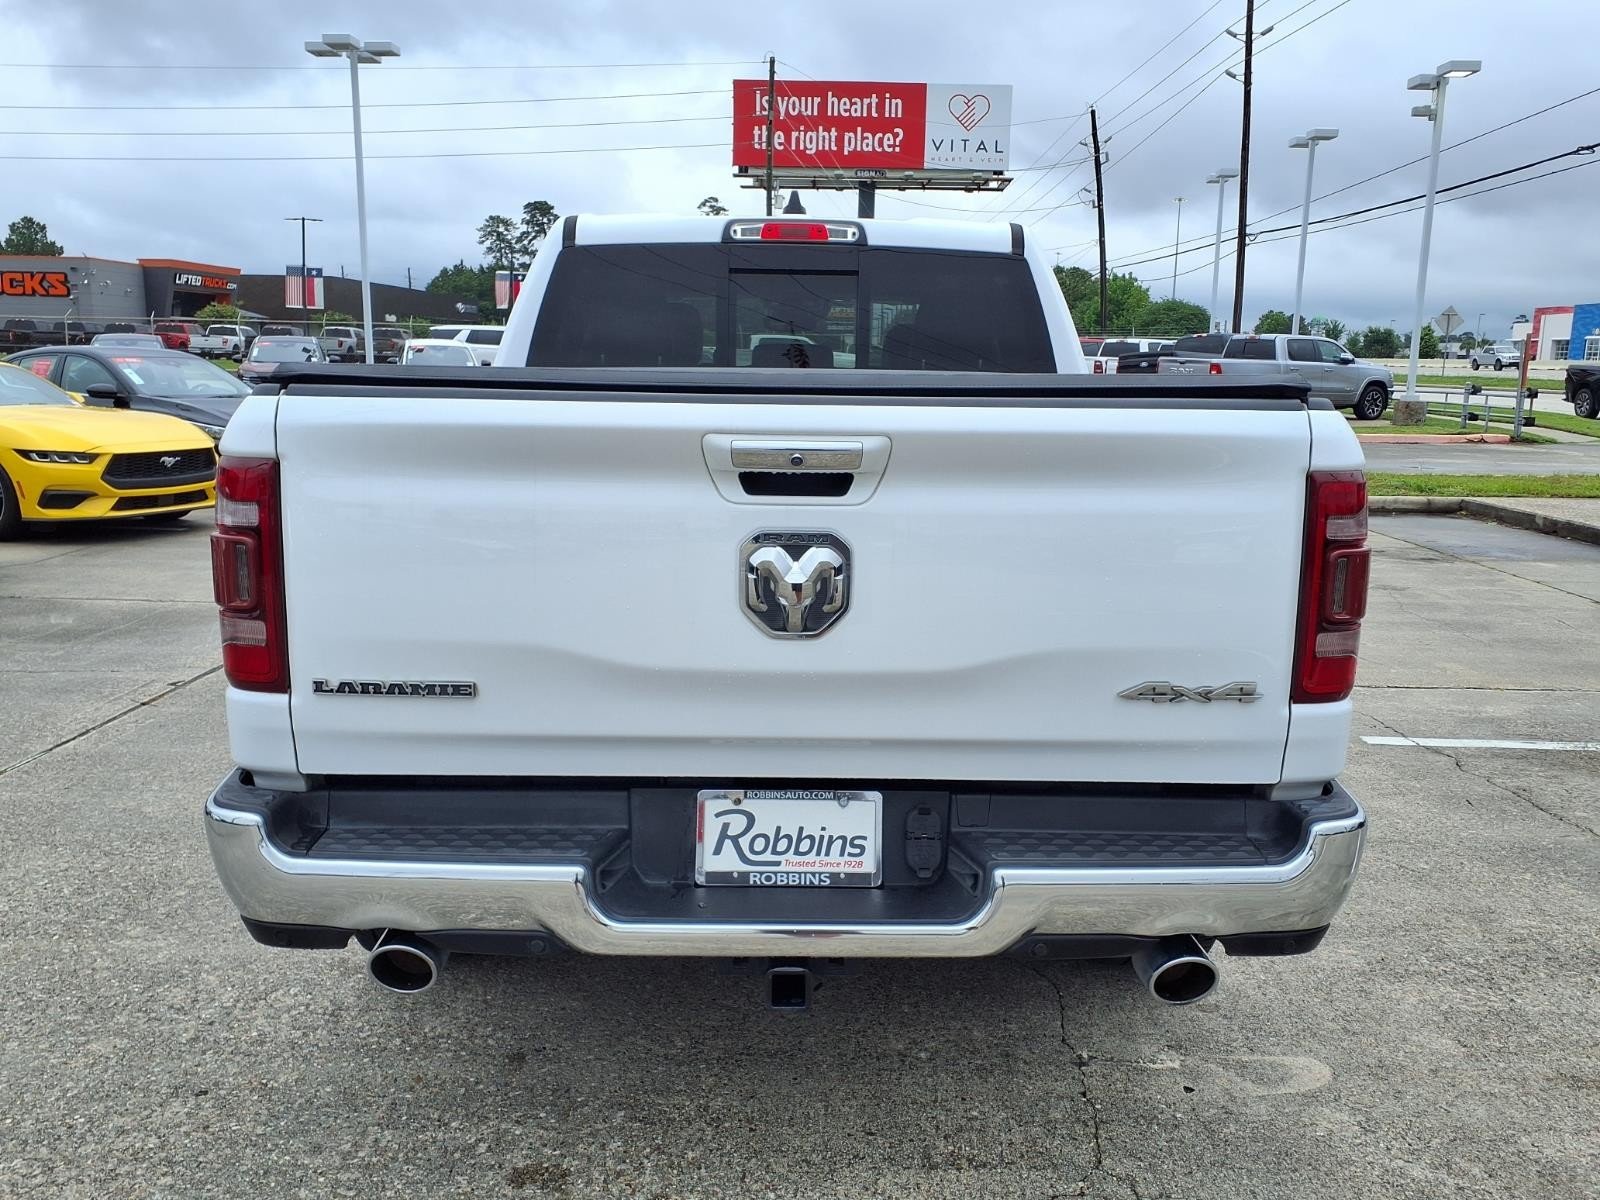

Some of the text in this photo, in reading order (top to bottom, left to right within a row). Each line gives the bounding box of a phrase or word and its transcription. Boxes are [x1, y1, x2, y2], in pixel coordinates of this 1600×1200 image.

[755, 90, 902, 119] Is your heart in
[791, 125, 838, 154] right
[843, 126, 904, 155] place?
[931, 138, 1004, 154] VITAL
[0, 272, 68, 296] CKS
[763, 534, 829, 543] RAM
[312, 679, 477, 698] LARAMIE
[746, 791, 834, 800] ROBBINSAUTO.COM
[712, 808, 868, 867] Robbins
[784, 859, 864, 869] Trusted Since 1928
[750, 872, 831, 886] ROBBINS
